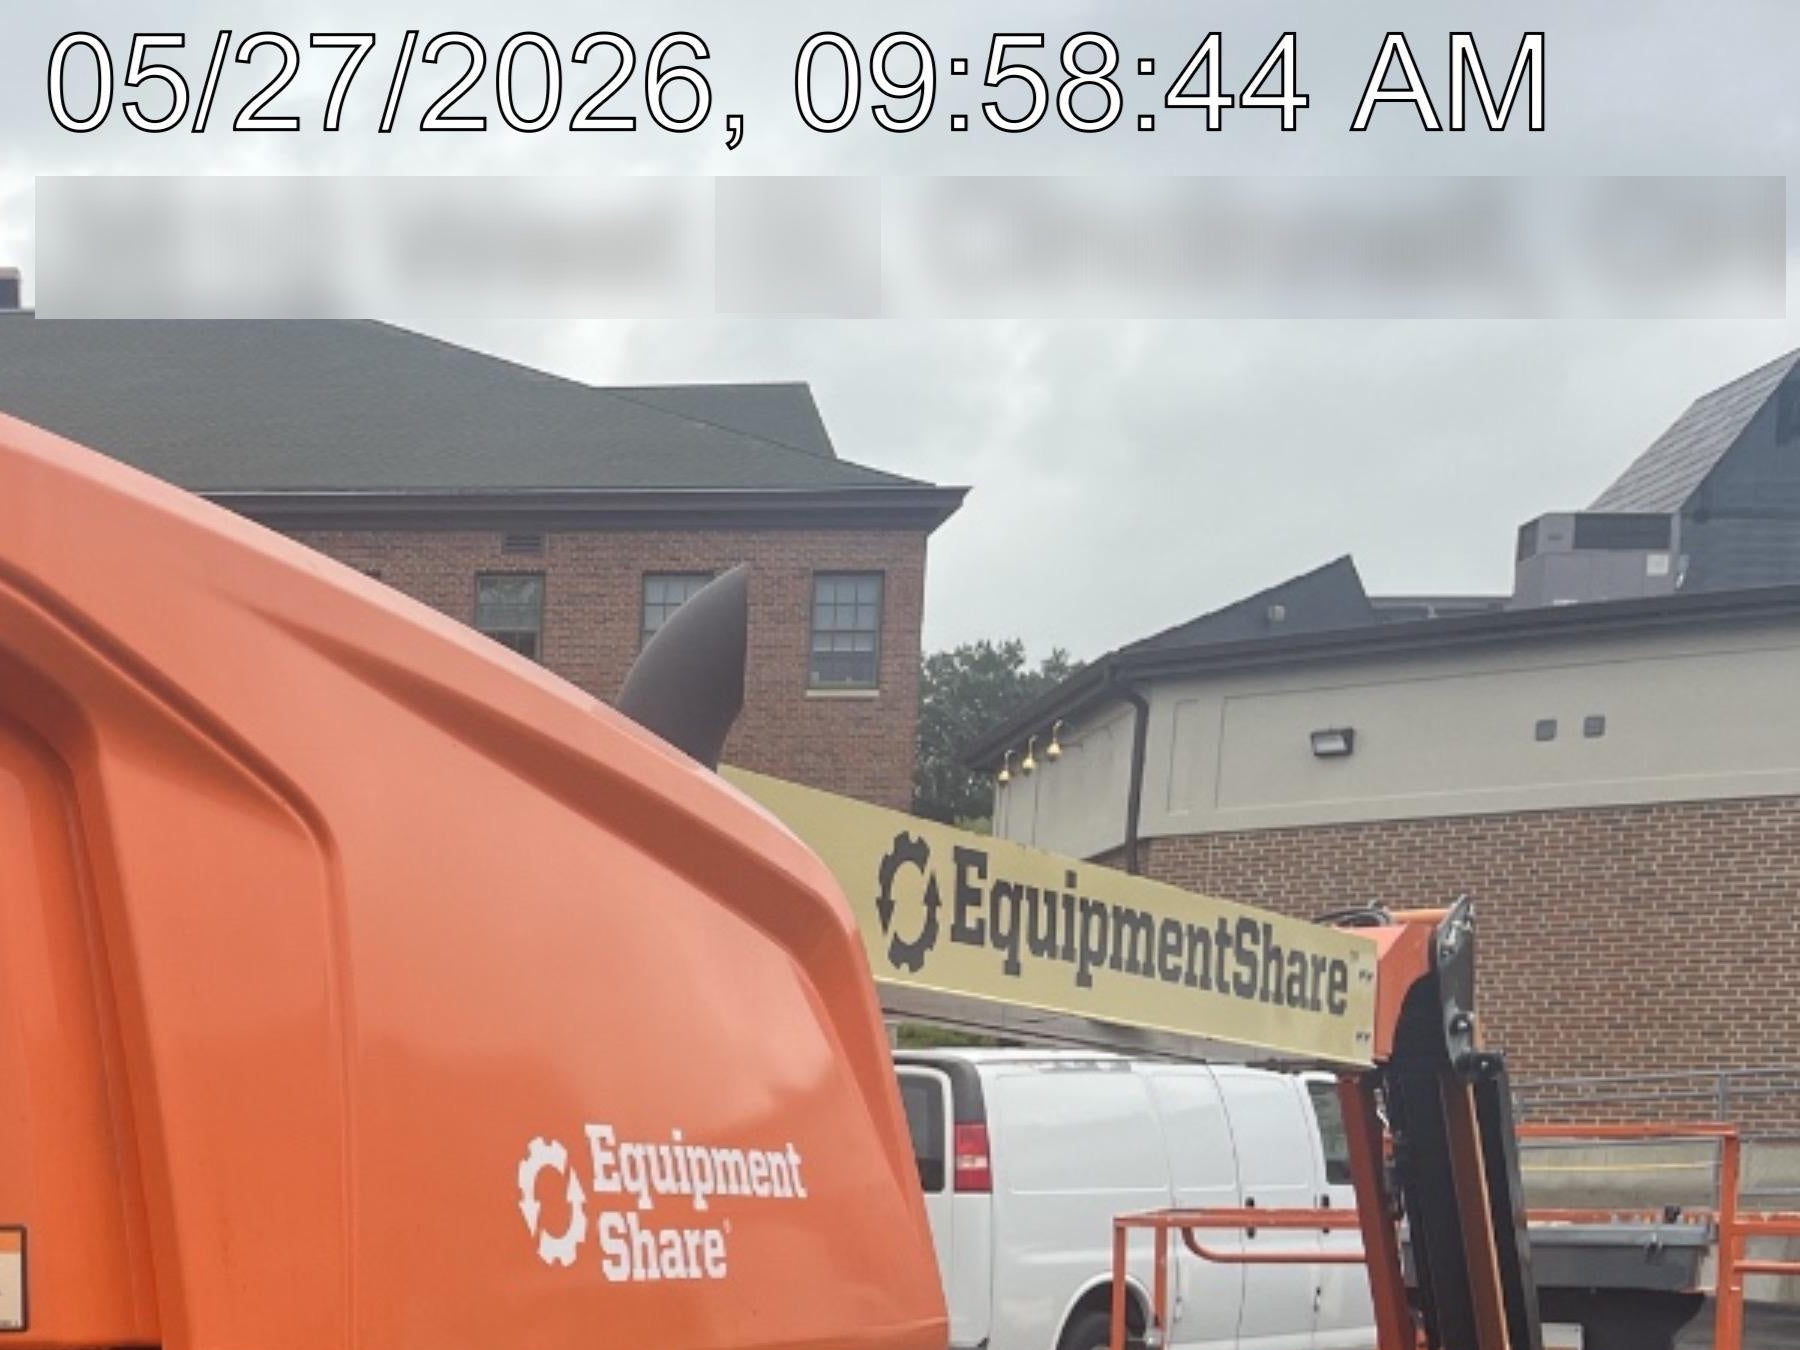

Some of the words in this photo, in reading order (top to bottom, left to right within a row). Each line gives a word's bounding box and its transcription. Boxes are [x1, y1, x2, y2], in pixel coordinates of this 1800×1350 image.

[950, 845, 1348, 1016] EquipmentShare
[584, 1123, 808, 1212] Equipment
[598, 1211, 727, 1283] Share
